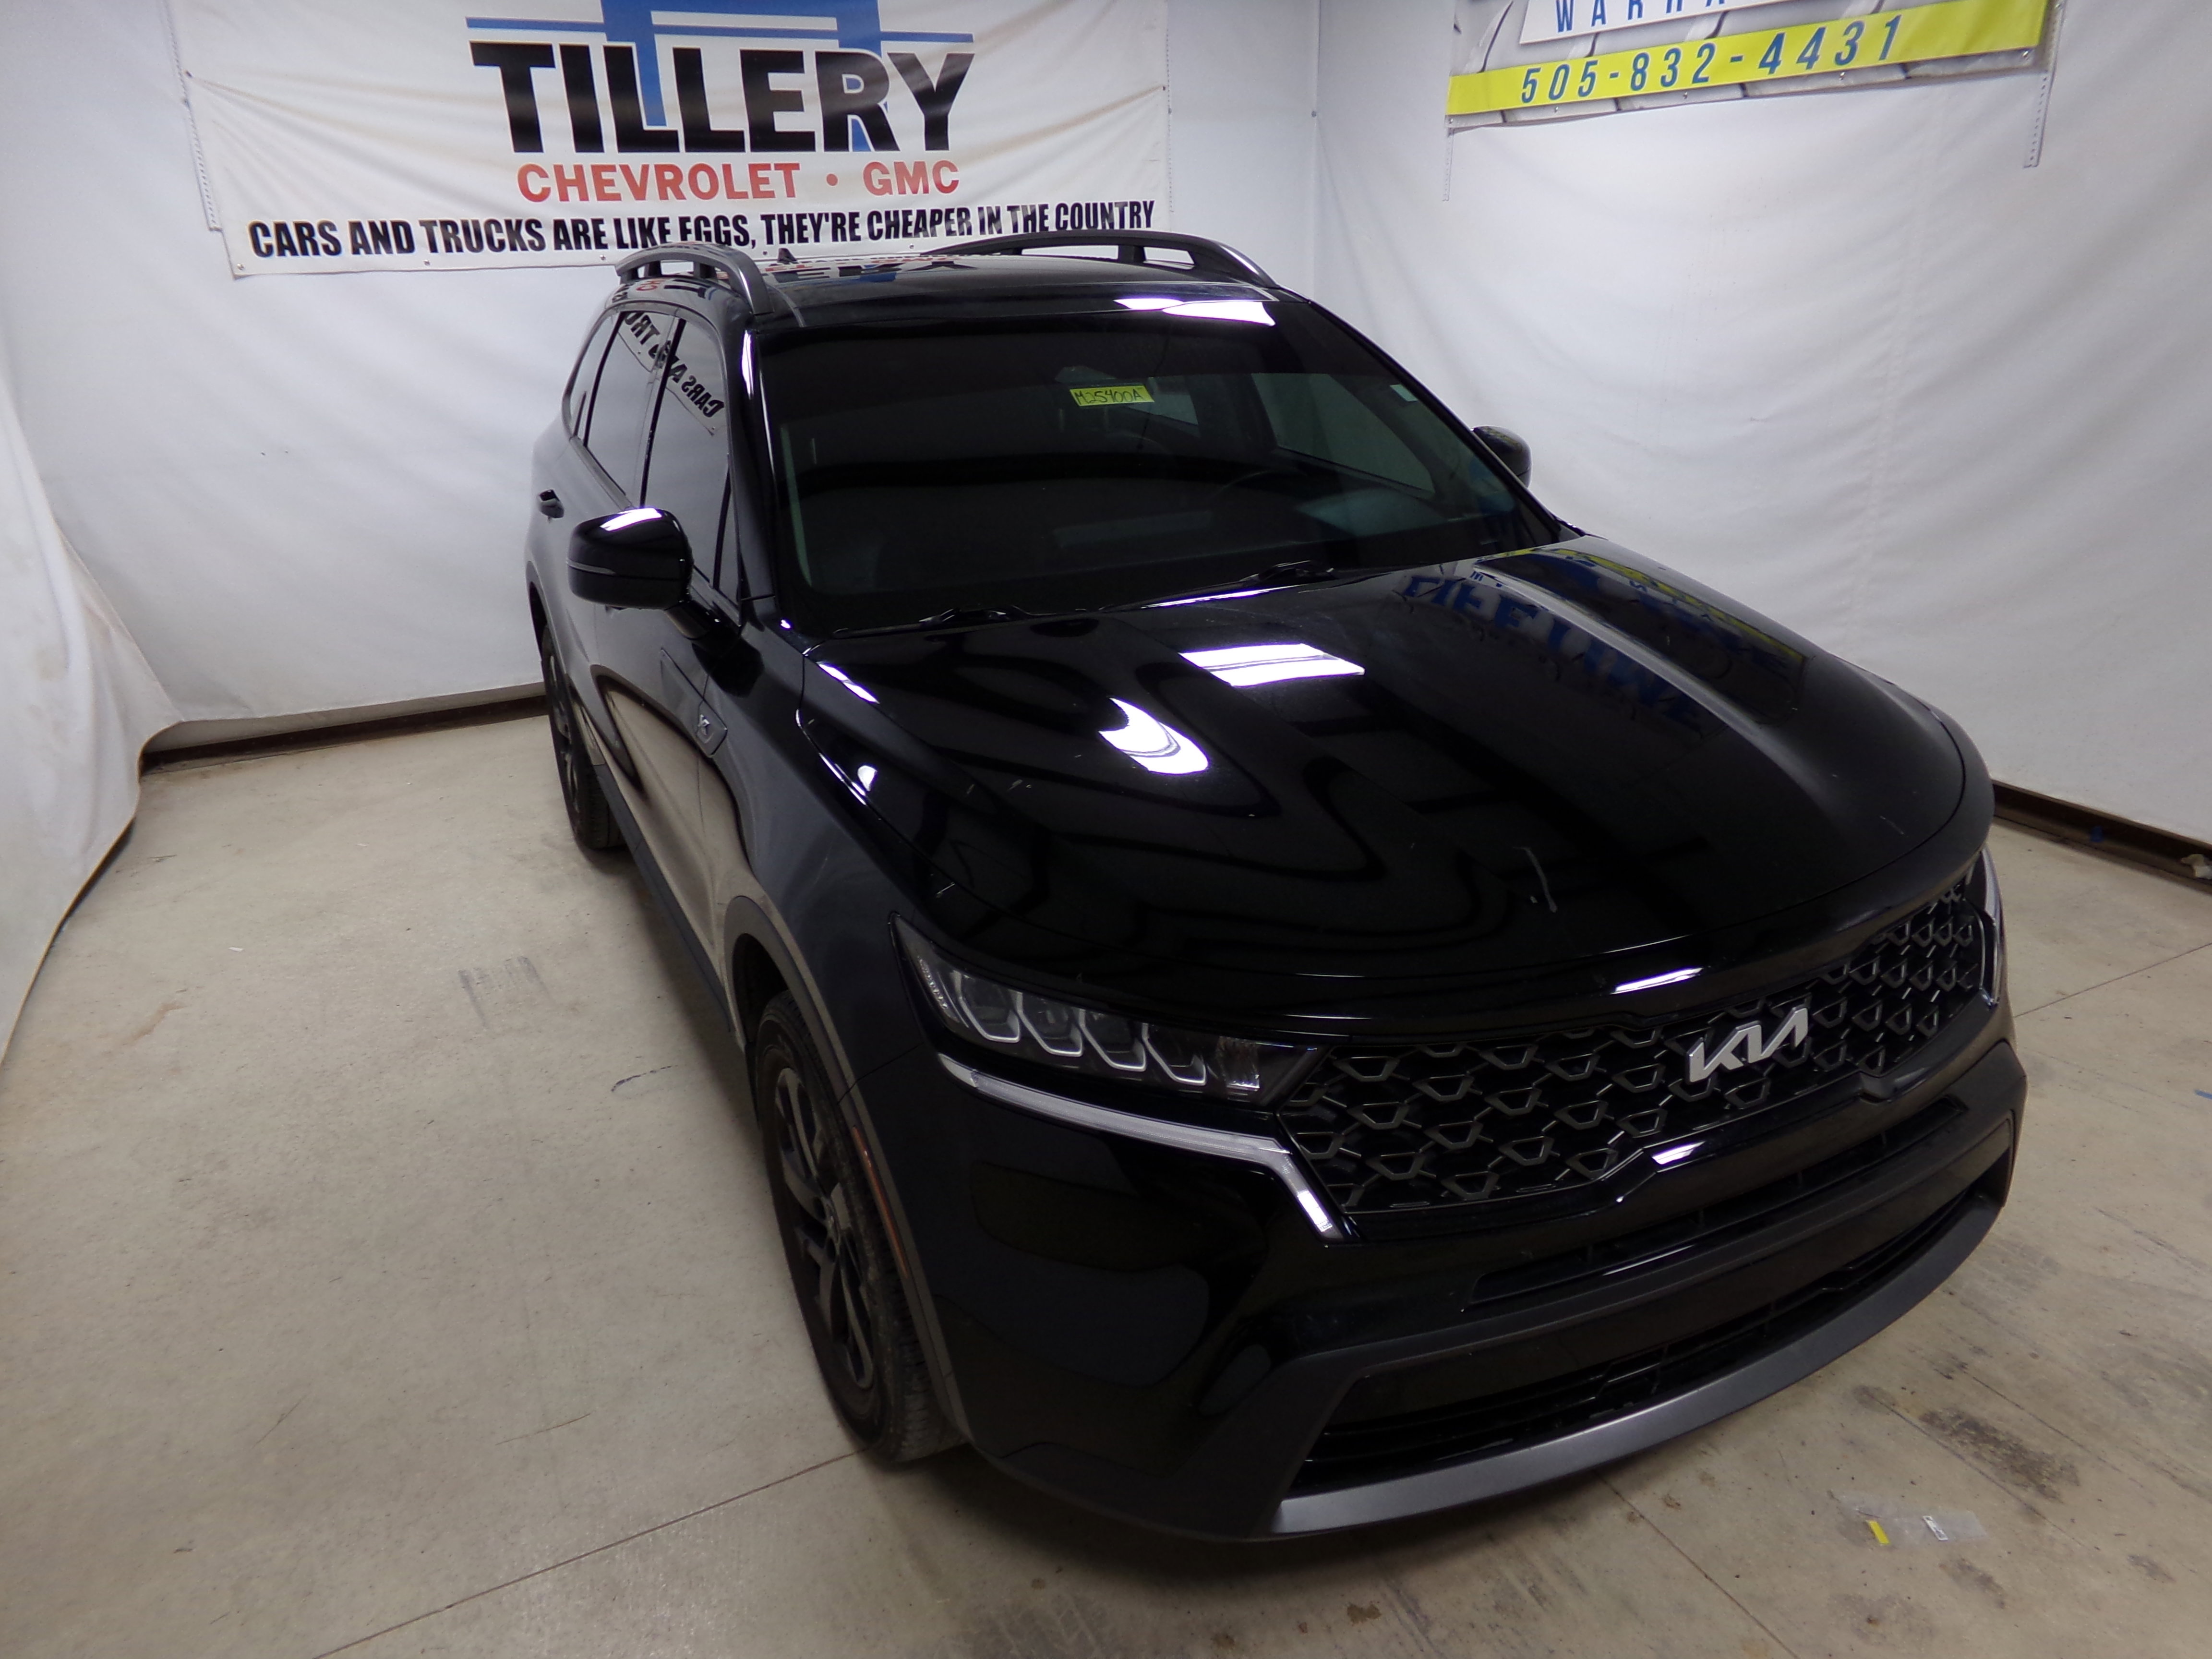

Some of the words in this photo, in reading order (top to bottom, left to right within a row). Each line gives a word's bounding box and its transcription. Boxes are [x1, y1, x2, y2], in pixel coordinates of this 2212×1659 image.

[469, 41, 974, 153] TILLERY
[1521, 15, 1900, 103] 505-832-4431
[517, 162, 801, 203] CHEVROLET
[863, 160, 960, 195] GMC
[249, 220, 342, 257] CARS
[350, 220, 415, 254] AND
[423, 219, 546, 253] TRUCKS
[553, 218, 608, 251] ARE
[613, 217, 671, 249] LIKE
[678, 215, 757, 249] EGGS,
[760, 211, 862, 245] THEY'RE
[867, 206, 972, 241] CHEAPER
[978, 205, 1003, 236] IN
[1006, 204, 1049, 233] THE
[1055, 201, 1155, 230] COUNTRY
[1687, 1004, 1808, 1082] KIA
